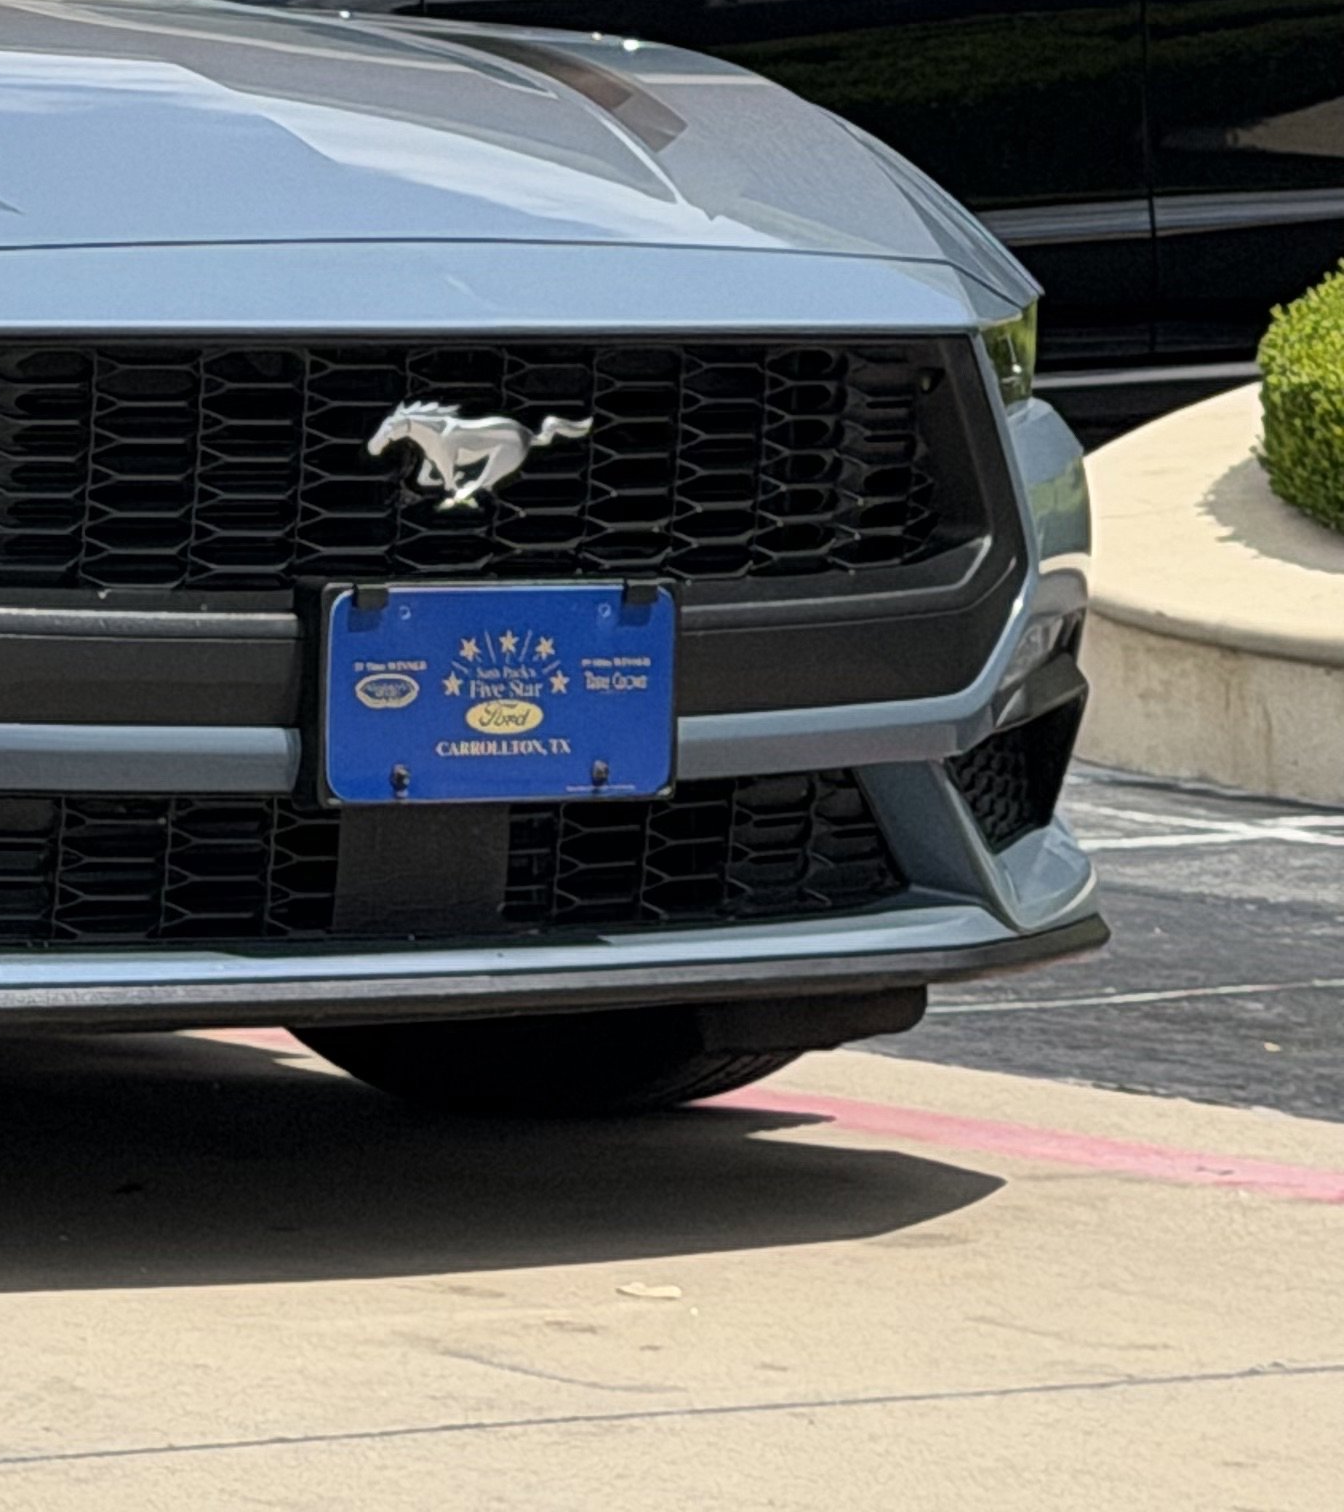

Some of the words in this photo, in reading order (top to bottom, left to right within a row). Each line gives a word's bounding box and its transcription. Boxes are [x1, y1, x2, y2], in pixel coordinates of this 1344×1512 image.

[469, 679, 506, 698] Five
[509, 679, 543, 698] Star
[477, 699, 531, 727] Ford
[548, 737, 571, 754] TX
